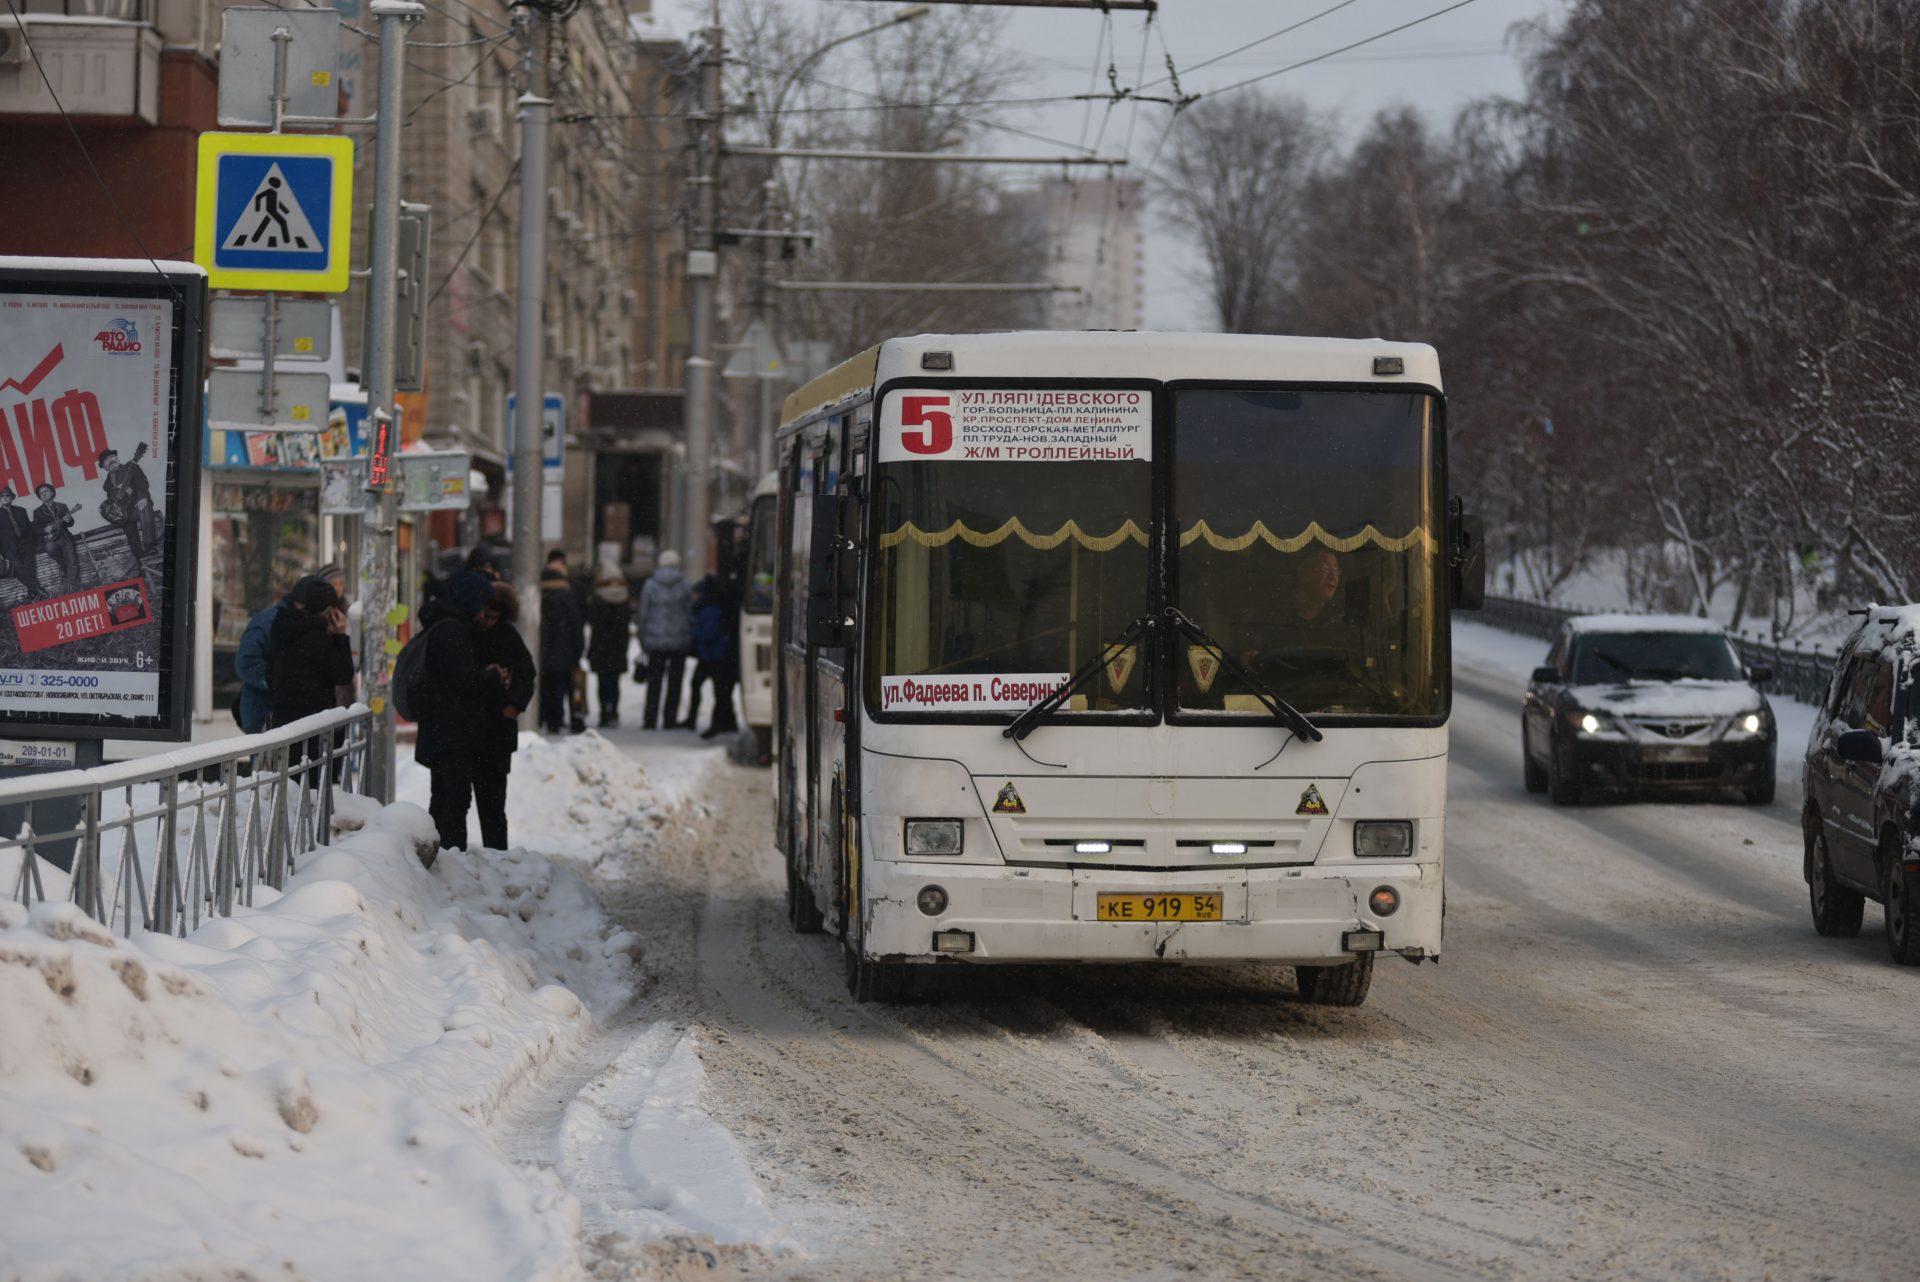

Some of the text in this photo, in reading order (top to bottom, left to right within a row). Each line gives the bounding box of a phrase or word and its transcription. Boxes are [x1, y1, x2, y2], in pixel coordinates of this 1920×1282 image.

[93, 331, 126, 342] АВТО
[102, 341, 142, 352] РАДИО
[963, 406, 1139, 415] ГОР.БОЛЬНИЦА-ПЛ.КАЛИНИНА
[901, 396, 953, 455] 5
[963, 416, 1122, 424] КР.ПРОСПЕКТ-ДОМ ЛЕНИНА
[963, 426, 1141, 434] ВОСХОД-ГОРСКАЯ-МЕТАЛЛУРГ
[963, 434, 1117, 443] ПЛ.ТРУДА-НОВ.ЗАПАДНЫЙ
[964, 444, 1134, 459] Ж/М ТРОЛЛЕЙНЫЙ
[16, 593, 100, 628] ШЕКОГАЛИМ
[56, 613, 105, 640] 20 ЛЕТ!
[136, 650, 154, 668] 6+
[41, 675, 99, 688] 325-0000
[884, 679, 969, 709] ул.Фадеева
[973, 683, 987, 701] п.
[22, 745, 67, 758] 209-01-01
[1108, 896, 1215, 917] КЕ 919 54
[1196, 911, 1212, 919] RUS
